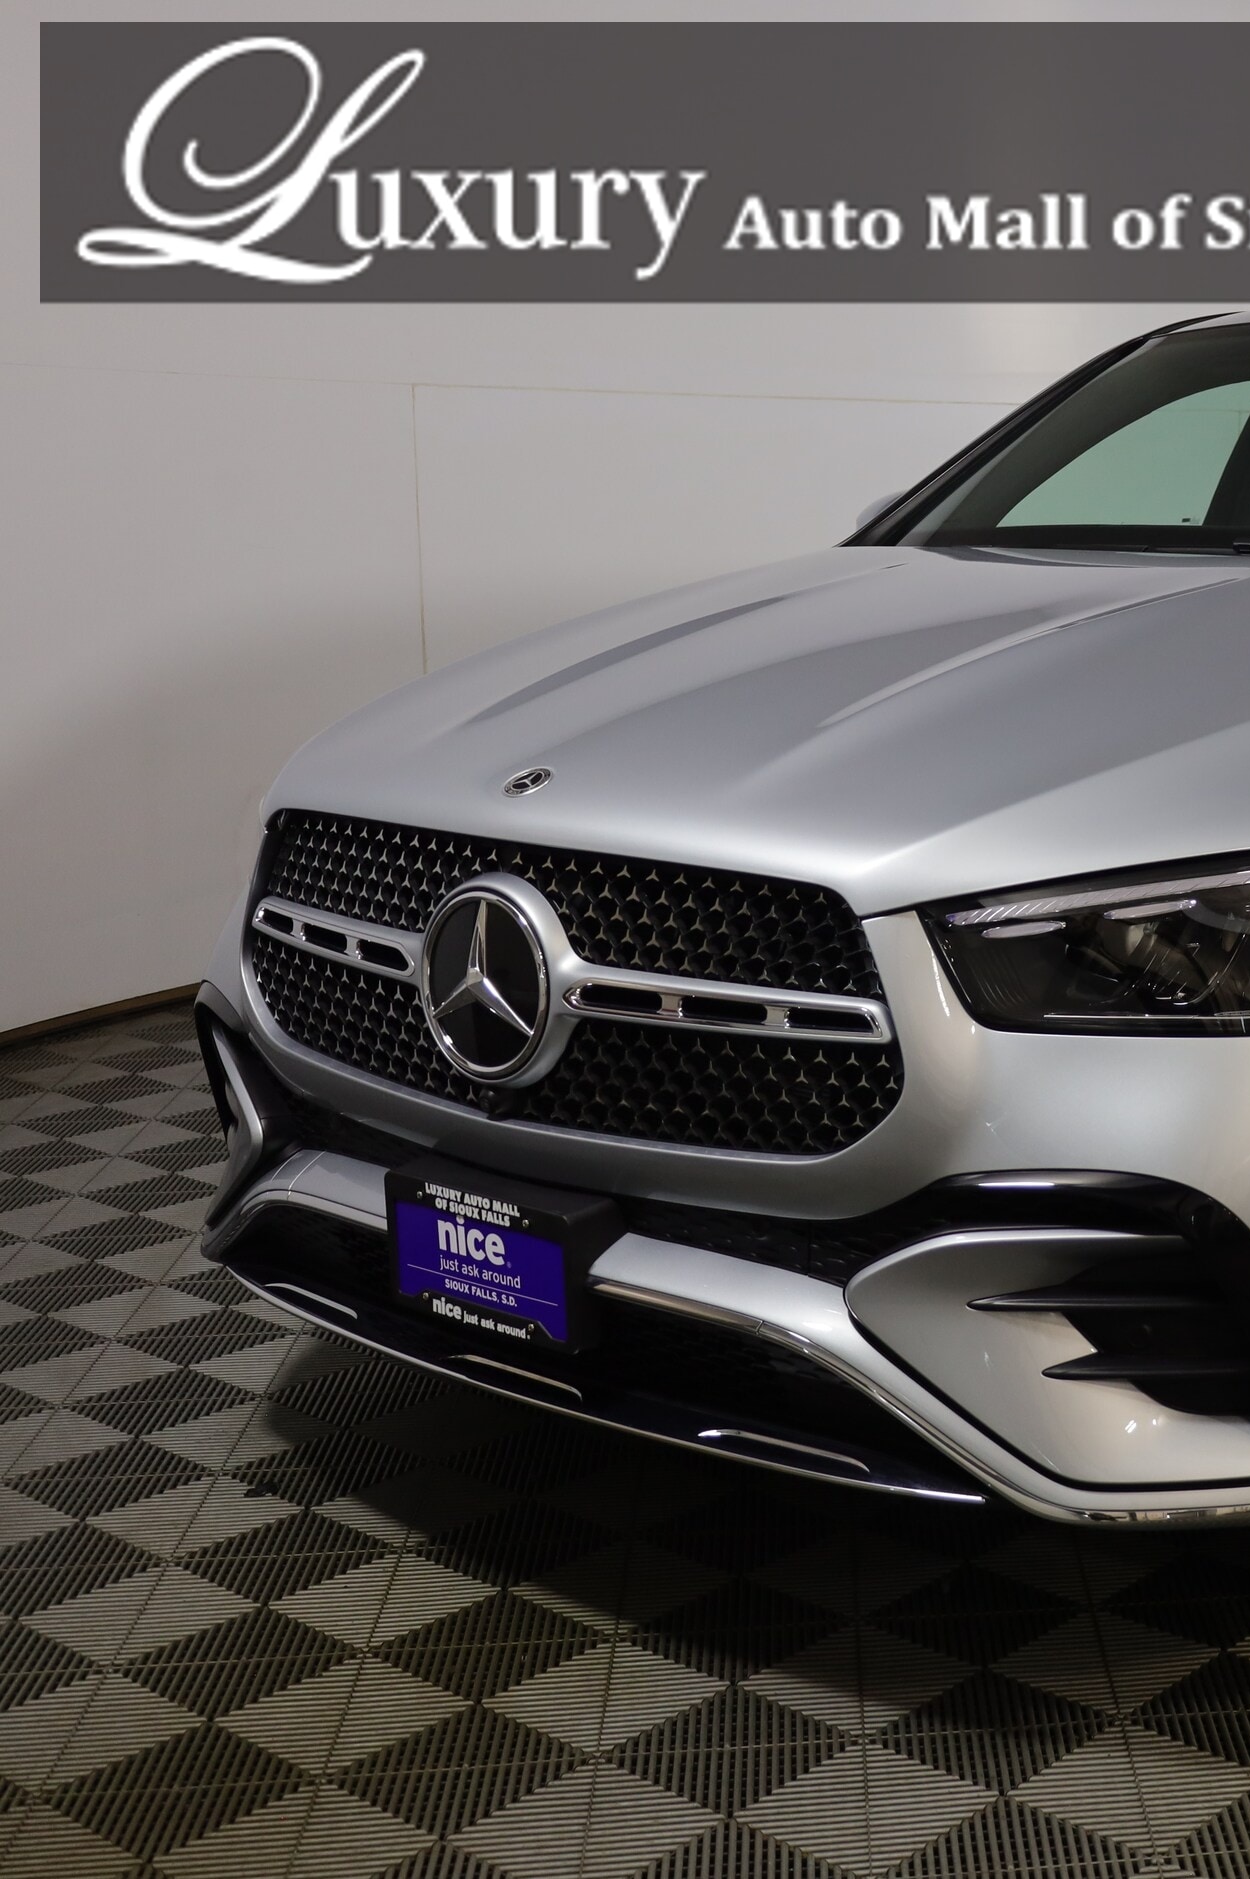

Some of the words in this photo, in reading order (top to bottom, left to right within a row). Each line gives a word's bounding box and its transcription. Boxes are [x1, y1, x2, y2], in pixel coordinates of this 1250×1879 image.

[424, 1182, 462, 1203] LUXURY
[463, 1193, 490, 1210] AUTO
[493, 1200, 520, 1217] MALL
[435, 1198, 448, 1211] OF
[449, 1201, 480, 1220] SIOUX
[481, 1208, 511, 1227] FALLS
[437, 1215, 506, 1266] nice
[439, 1255, 459, 1271] just
[461, 1259, 480, 1278] ask
[482, 1265, 521, 1289] around
[444, 1278, 470, 1295] SIOUX
[471, 1286, 500, 1303] FALLS,
[501, 1293, 518, 1307] S.D.
[432, 1296, 462, 1320] nice
[463, 1310, 479, 1325] just
[480, 1318, 495, 1331] ask
